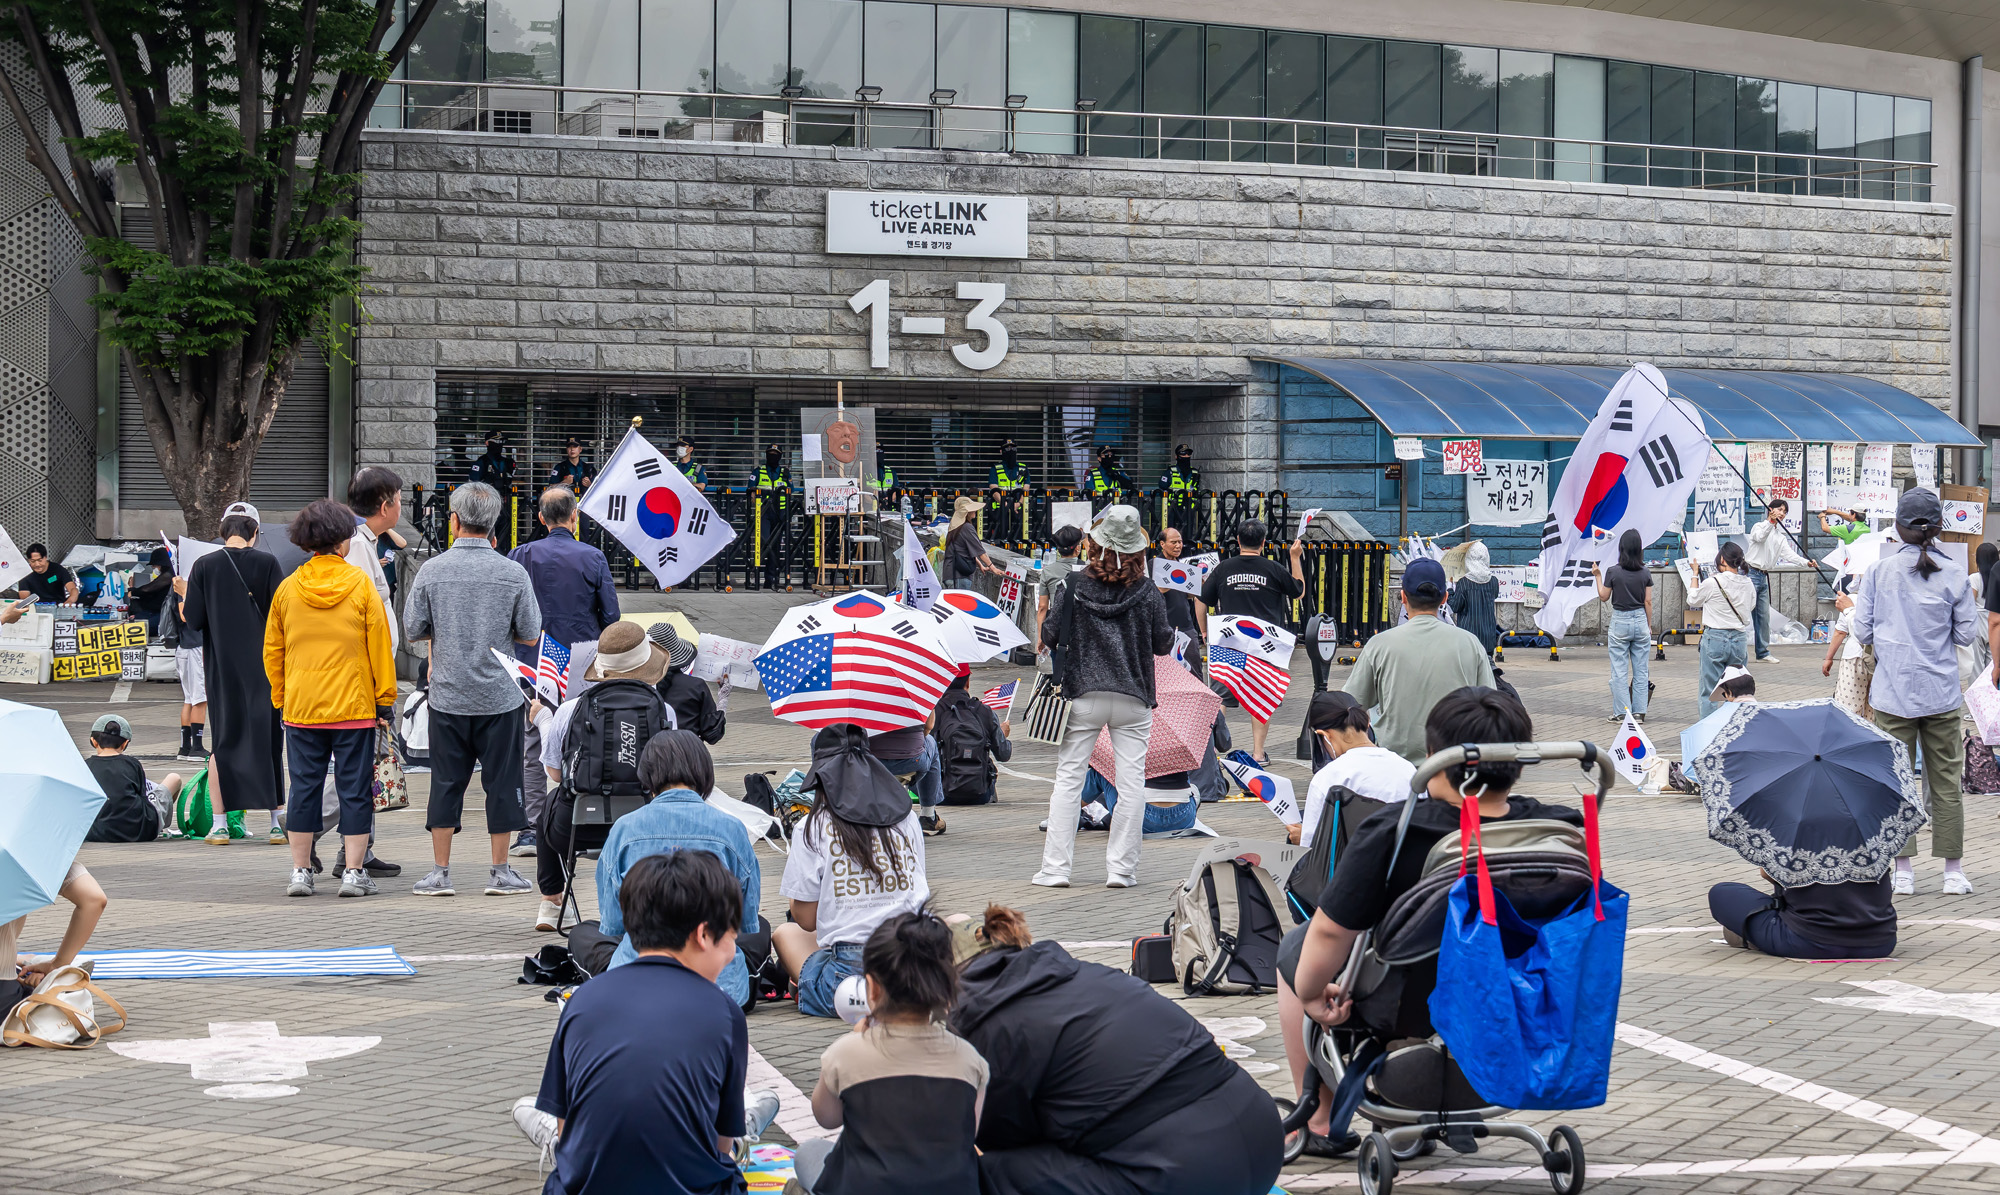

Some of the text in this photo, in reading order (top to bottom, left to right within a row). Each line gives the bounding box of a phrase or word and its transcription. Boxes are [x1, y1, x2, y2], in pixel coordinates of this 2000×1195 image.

[870, 199, 988, 222] ticketLINK
[881, 221, 976, 236] LIVE ARENA
[906, 240, 953, 250] 핸드볼 경기장
[847, 279, 1009, 371] 1-3
[1487, 489, 1533, 512] 재선거
[1856, 491, 1889, 502] 선관위
[1696, 497, 1743, 528] 재선거
[1226, 573, 1267, 586] SHOHOKU
[55, 622, 77, 635] 누가
[81, 625, 146, 650] 내란은
[55, 641, 77, 651] 봐도
[54, 651, 121, 678] 선관위
[123, 667, 144, 678] 하라
